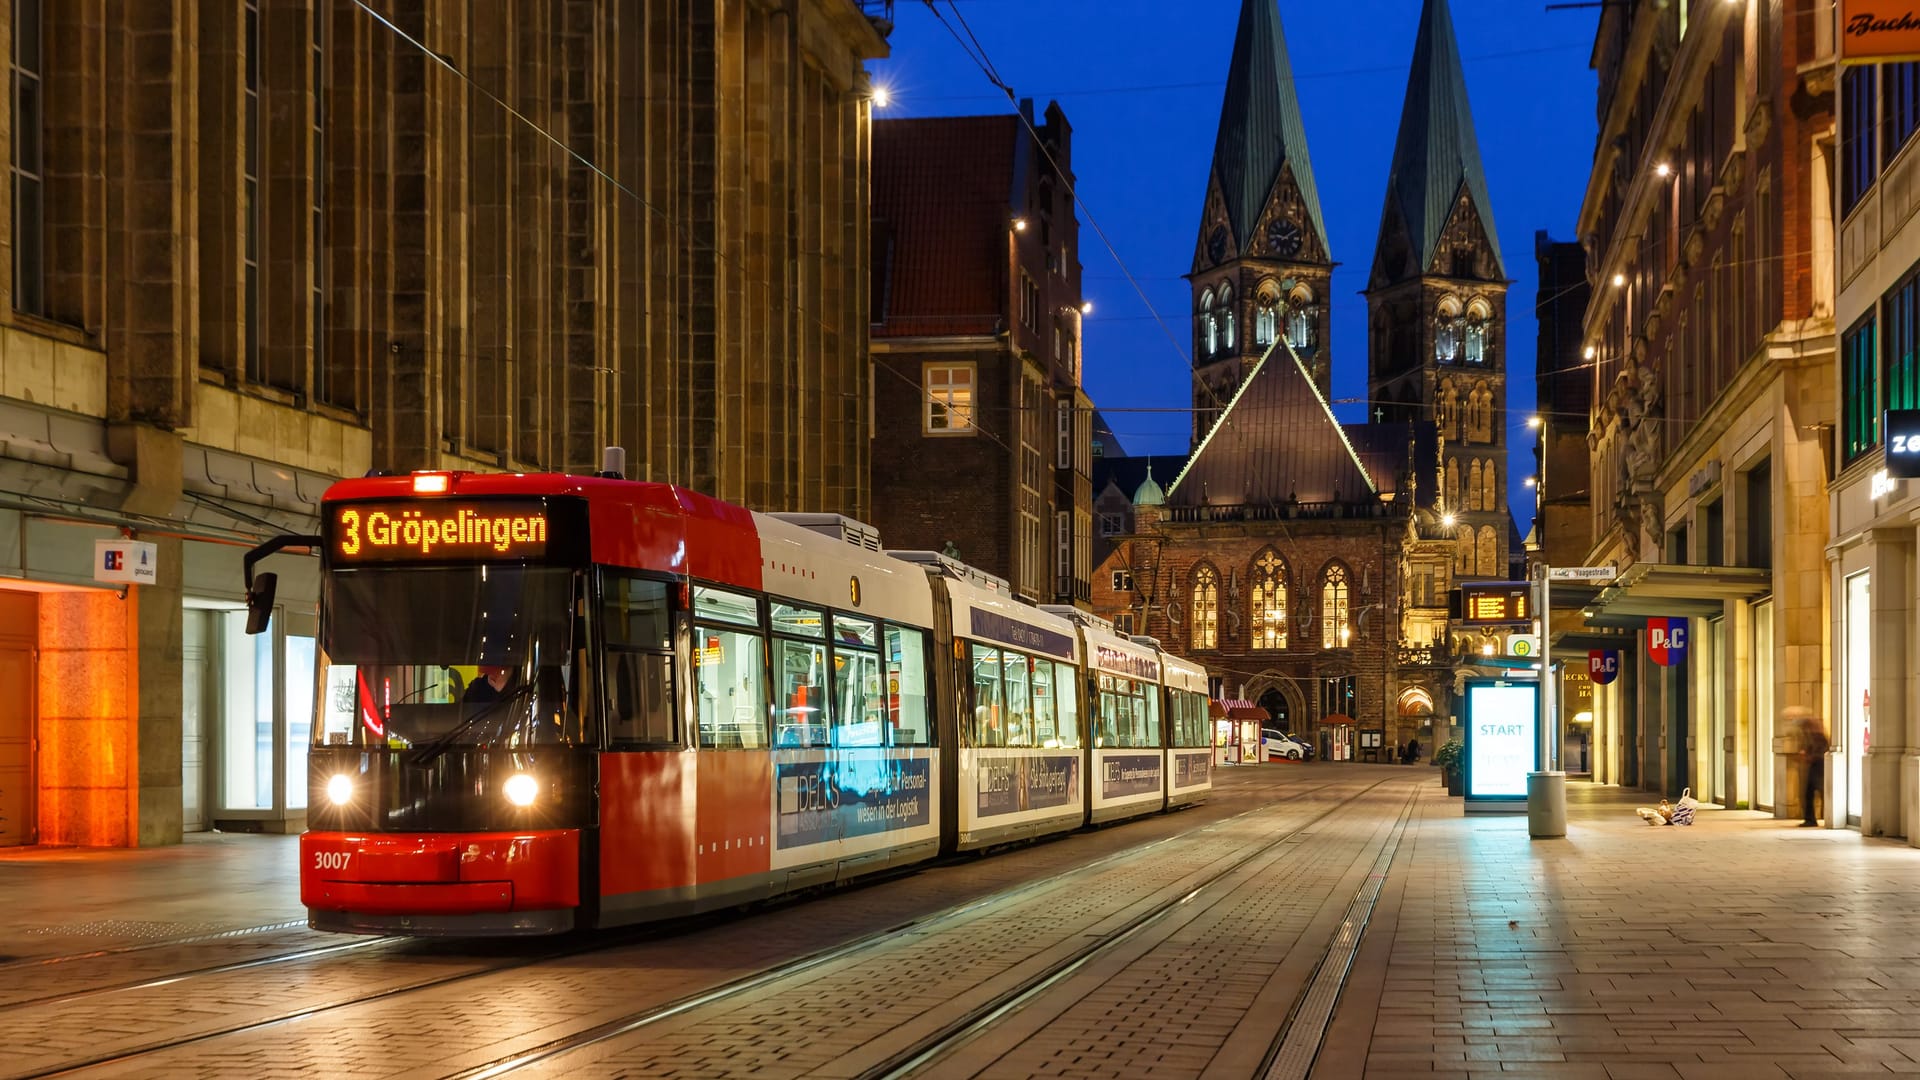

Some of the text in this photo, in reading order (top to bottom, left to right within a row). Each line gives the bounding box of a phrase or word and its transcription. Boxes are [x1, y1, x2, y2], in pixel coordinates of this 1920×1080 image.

[341, 509, 546, 555] 3 Gröpelingen
[1651, 628, 1684, 649] P&C
[1591, 657, 1616, 673] P&C
[1480, 724, 1525, 736] START
[901, 768, 927, 790] Personal-
[857, 795, 919, 823] wesen in der Logistik
[314, 851, 352, 870] 3007
